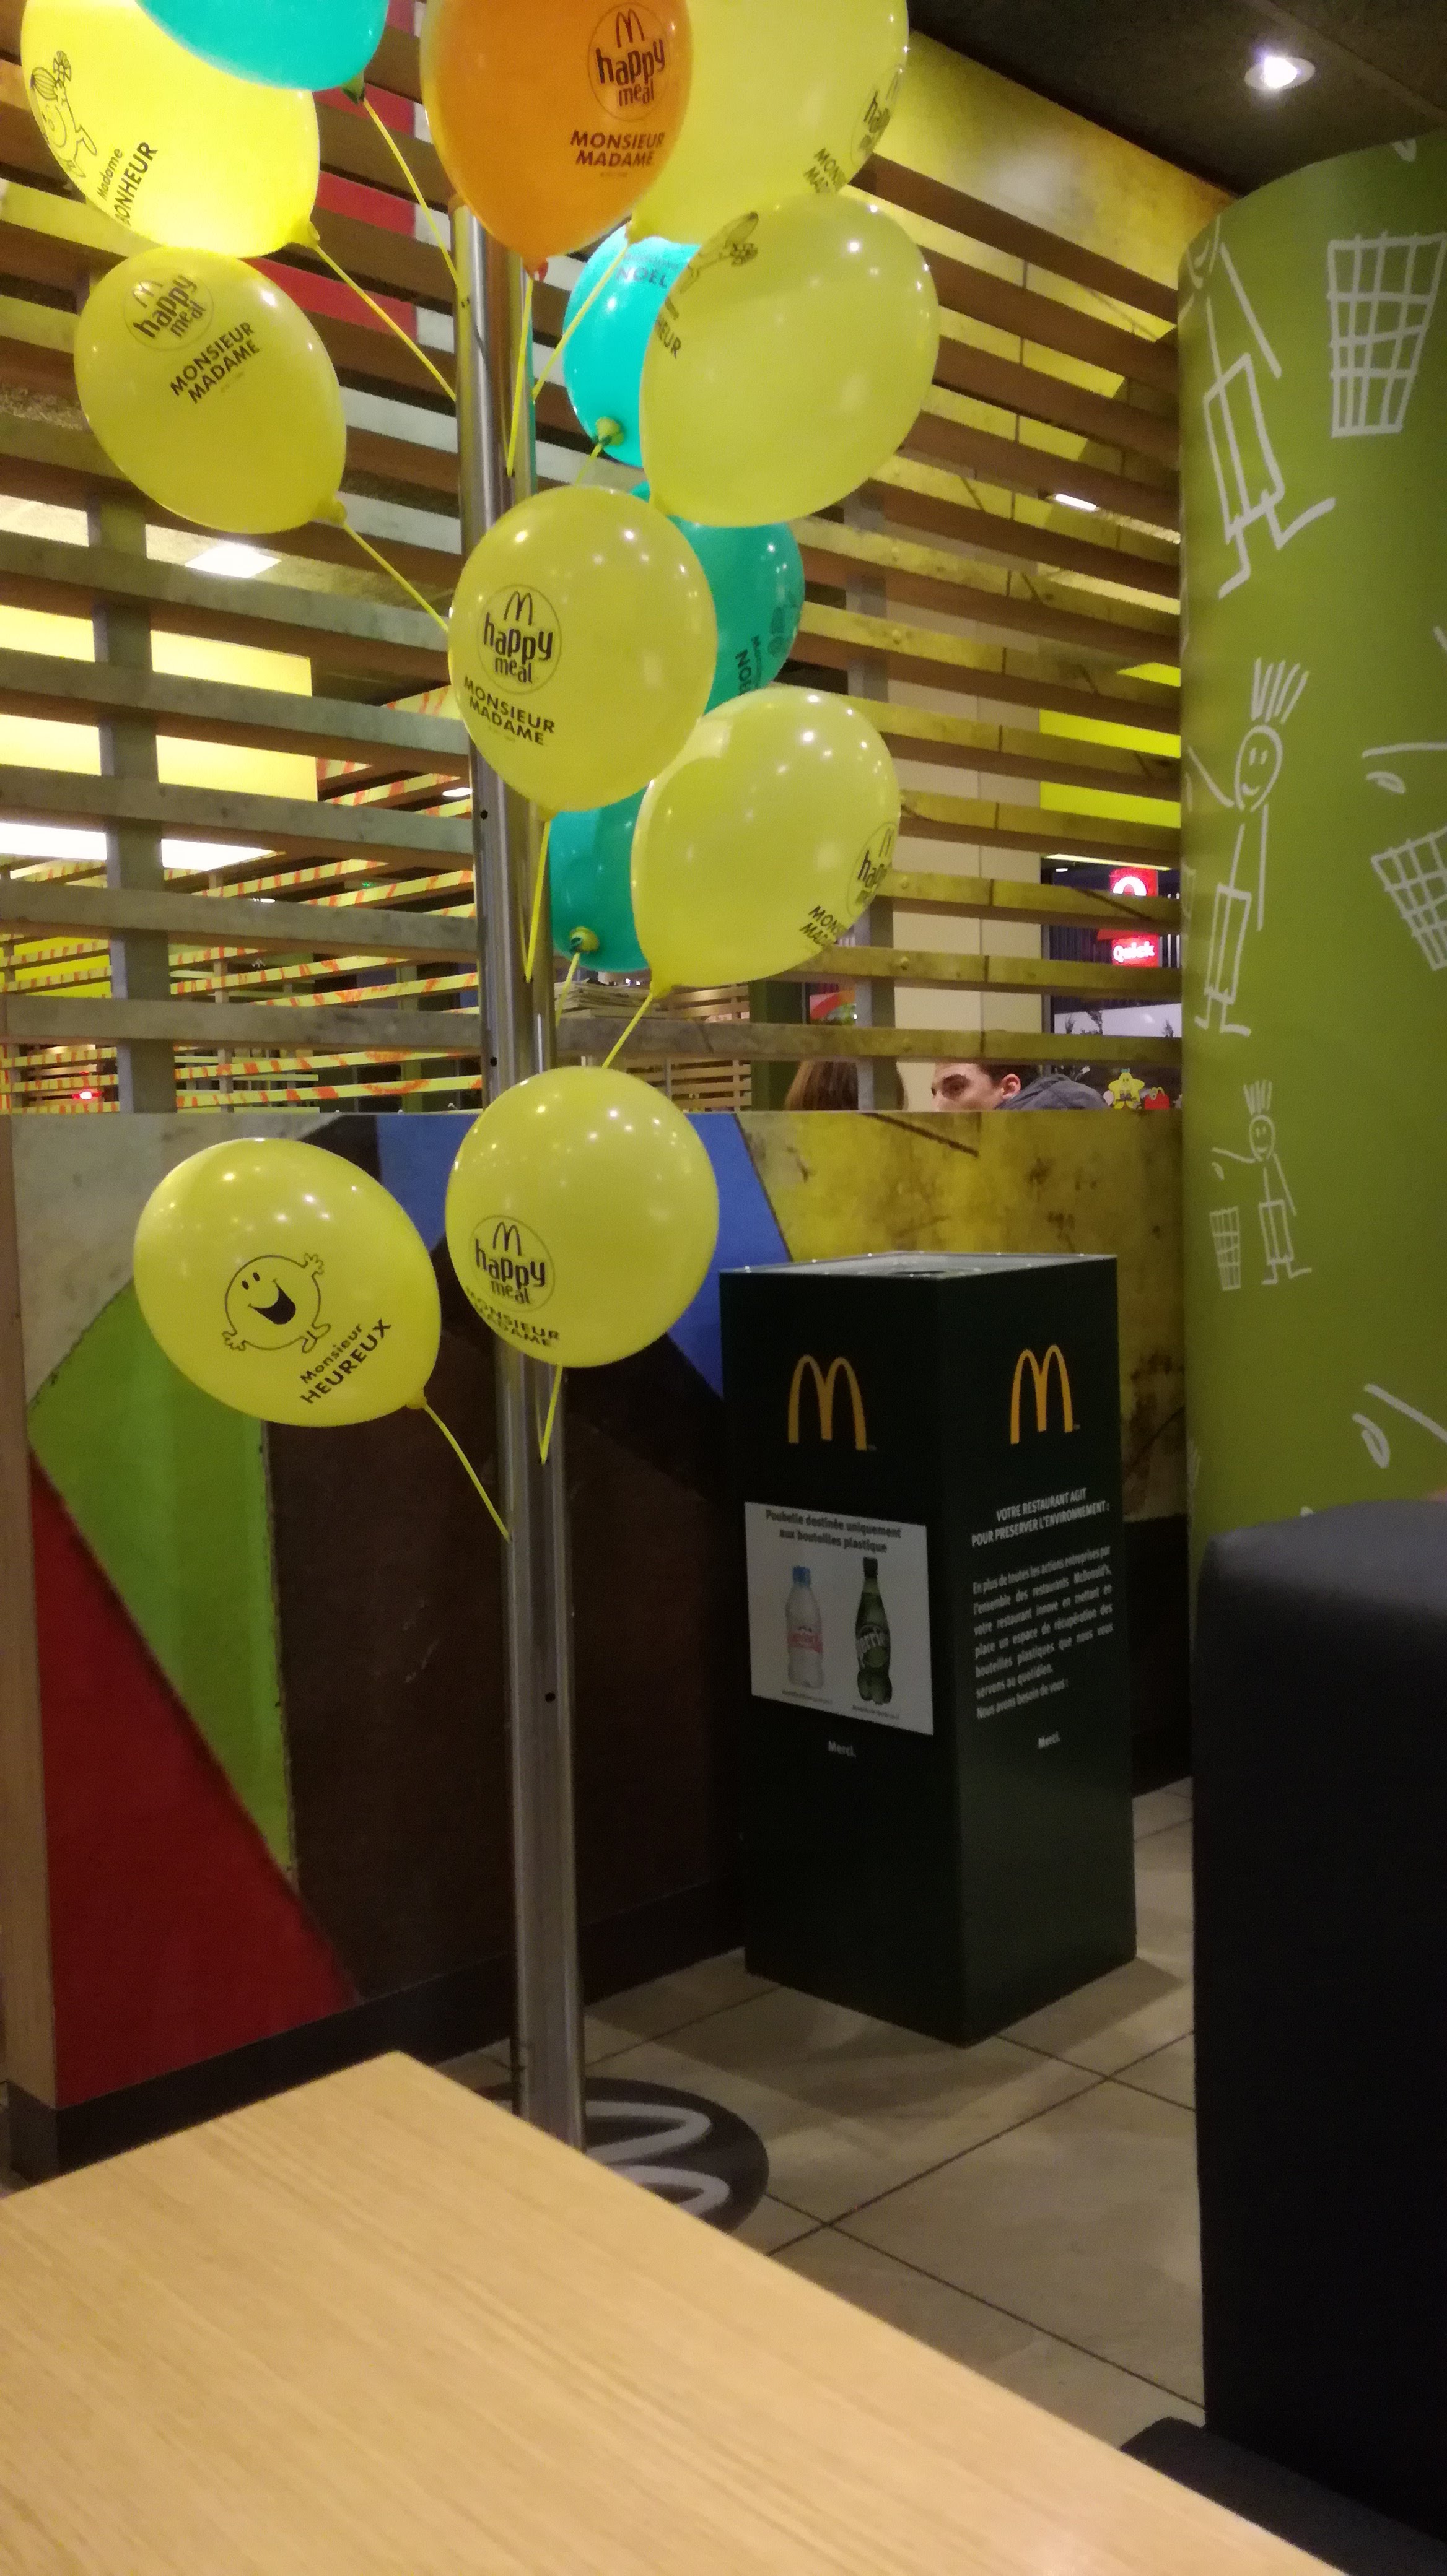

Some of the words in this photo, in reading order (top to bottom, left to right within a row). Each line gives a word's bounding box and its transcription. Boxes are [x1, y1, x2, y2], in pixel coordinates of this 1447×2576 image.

[595, 39, 665, 86] happy
[619, 84, 655, 107] meal
[570, 129, 665, 150] MONSIEUR
[97, 149, 123, 201] Madame
[575, 150, 654, 167] MADAME
[132, 274, 199, 339] happy
[170, 302, 207, 339] meal
[169, 321, 255, 396] MONSIEUR
[187, 340, 261, 404] MADAME
[483, 612, 553, 665] happy
[494, 658, 533, 684] meal
[463, 675, 555, 734] MONSIEUR
[469, 695, 544, 746] MADAME
[1113, 941, 1155, 964] Quick
[475, 1238, 546, 1289] happy
[491, 1281, 531, 1305] meal
[299, 1323, 364, 1385] Monsieur
[300, 1318, 391, 1405] HEUREUX
[996, 1504, 1021, 1521] VOTRE
[1022, 1492, 1069, 1515] RESTAURANT
[1070, 1487, 1086, 1502] AGIT
[766, 1509, 803, 1525] Poubelle
[846, 1522, 901, 1538] uniquement
[971, 1530, 994, 1547] POUR
[995, 1518, 1038, 1541] PRESERVER
[780, 1529, 795, 1539] aux
[797, 1530, 841, 1547] bouteilles
[844, 1537, 888, 1553] plastique
[973, 1582, 982, 1595] En
[983, 1578, 998, 1595] plus
[999, 1574, 1007, 1586] de
[1016, 1589, 1028, 1602] des
[1033, 1577, 1069, 1598] restaurants
[974, 1622, 992, 1635] votre
[997, 1608, 1032, 1629] restaurant
[975, 1642, 995, 1660] place
[1012, 1627, 1038, 1644] espace
[976, 1656, 1013, 1678] bouteilles
[1017, 1642, 1055, 1666] plastiques
[977, 1705, 995, 1720] Nous
